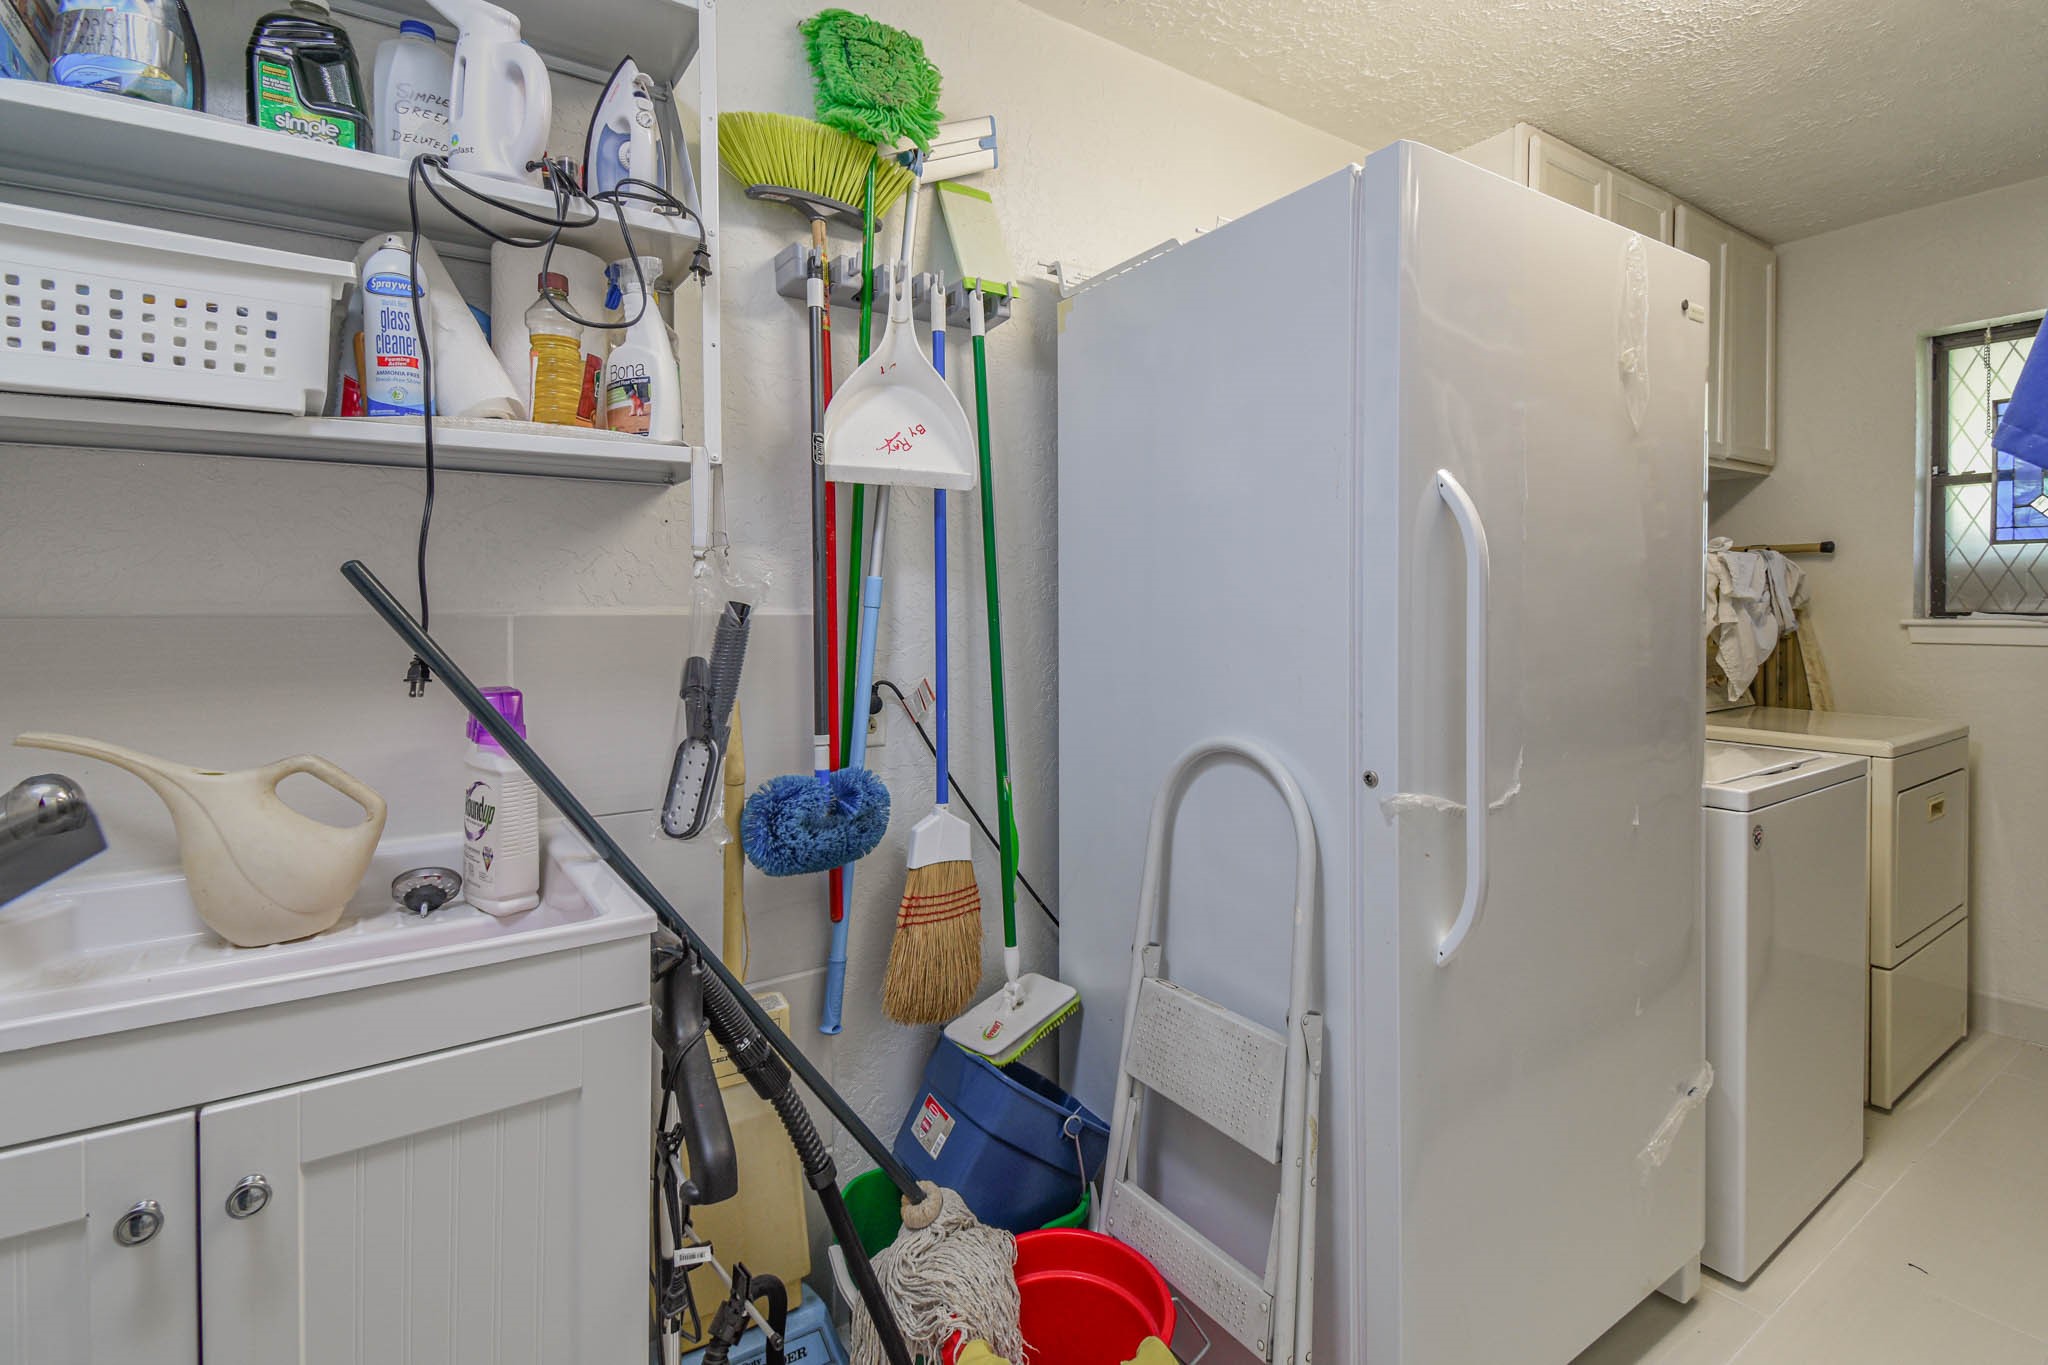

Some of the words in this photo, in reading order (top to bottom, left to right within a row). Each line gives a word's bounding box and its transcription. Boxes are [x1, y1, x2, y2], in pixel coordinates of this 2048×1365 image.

[275, 112, 340, 138] simple
[371, 278, 414, 291] Spraywa
[380, 307, 410, 333] glass
[376, 332, 417, 356] cleaner
[610, 363, 646, 382] Bona
